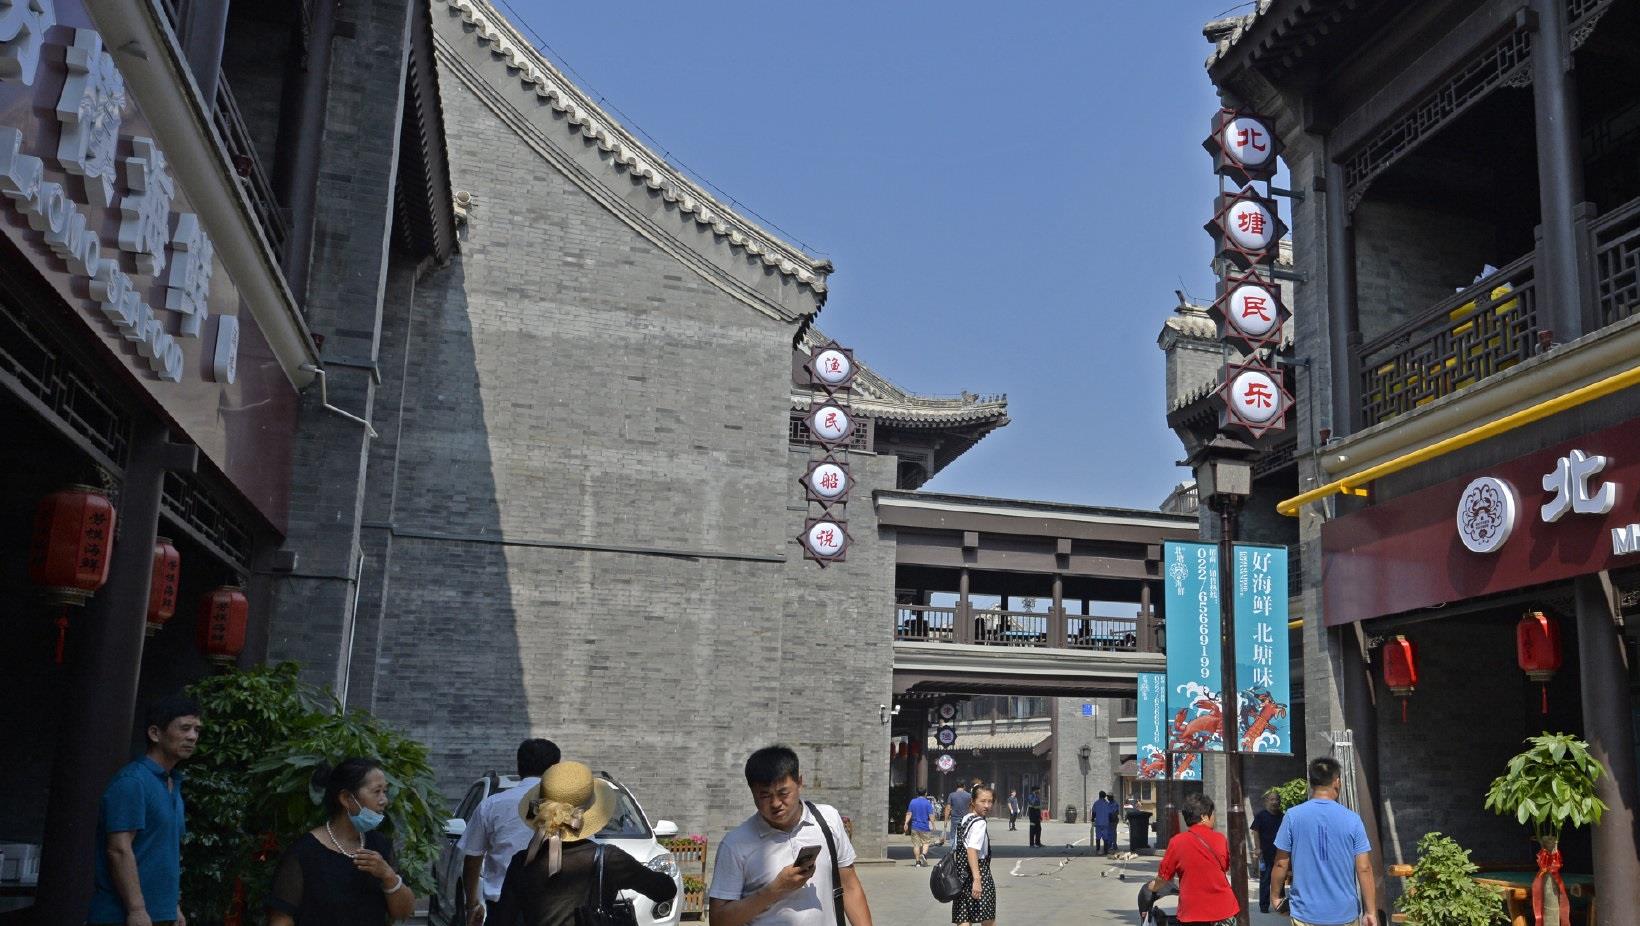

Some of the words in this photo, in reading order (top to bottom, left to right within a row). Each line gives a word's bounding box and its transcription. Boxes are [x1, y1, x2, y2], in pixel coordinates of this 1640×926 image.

[90, 258, 184, 384] SEAFOOD
[816, 357, 842, 548] 渔民船说
[1541, 449, 1616, 523] 北
[1197, 547, 1210, 679] 022/65669199
[1252, 551, 1273, 617] 好海鲜
[1252, 622, 1274, 688] 北塘味
